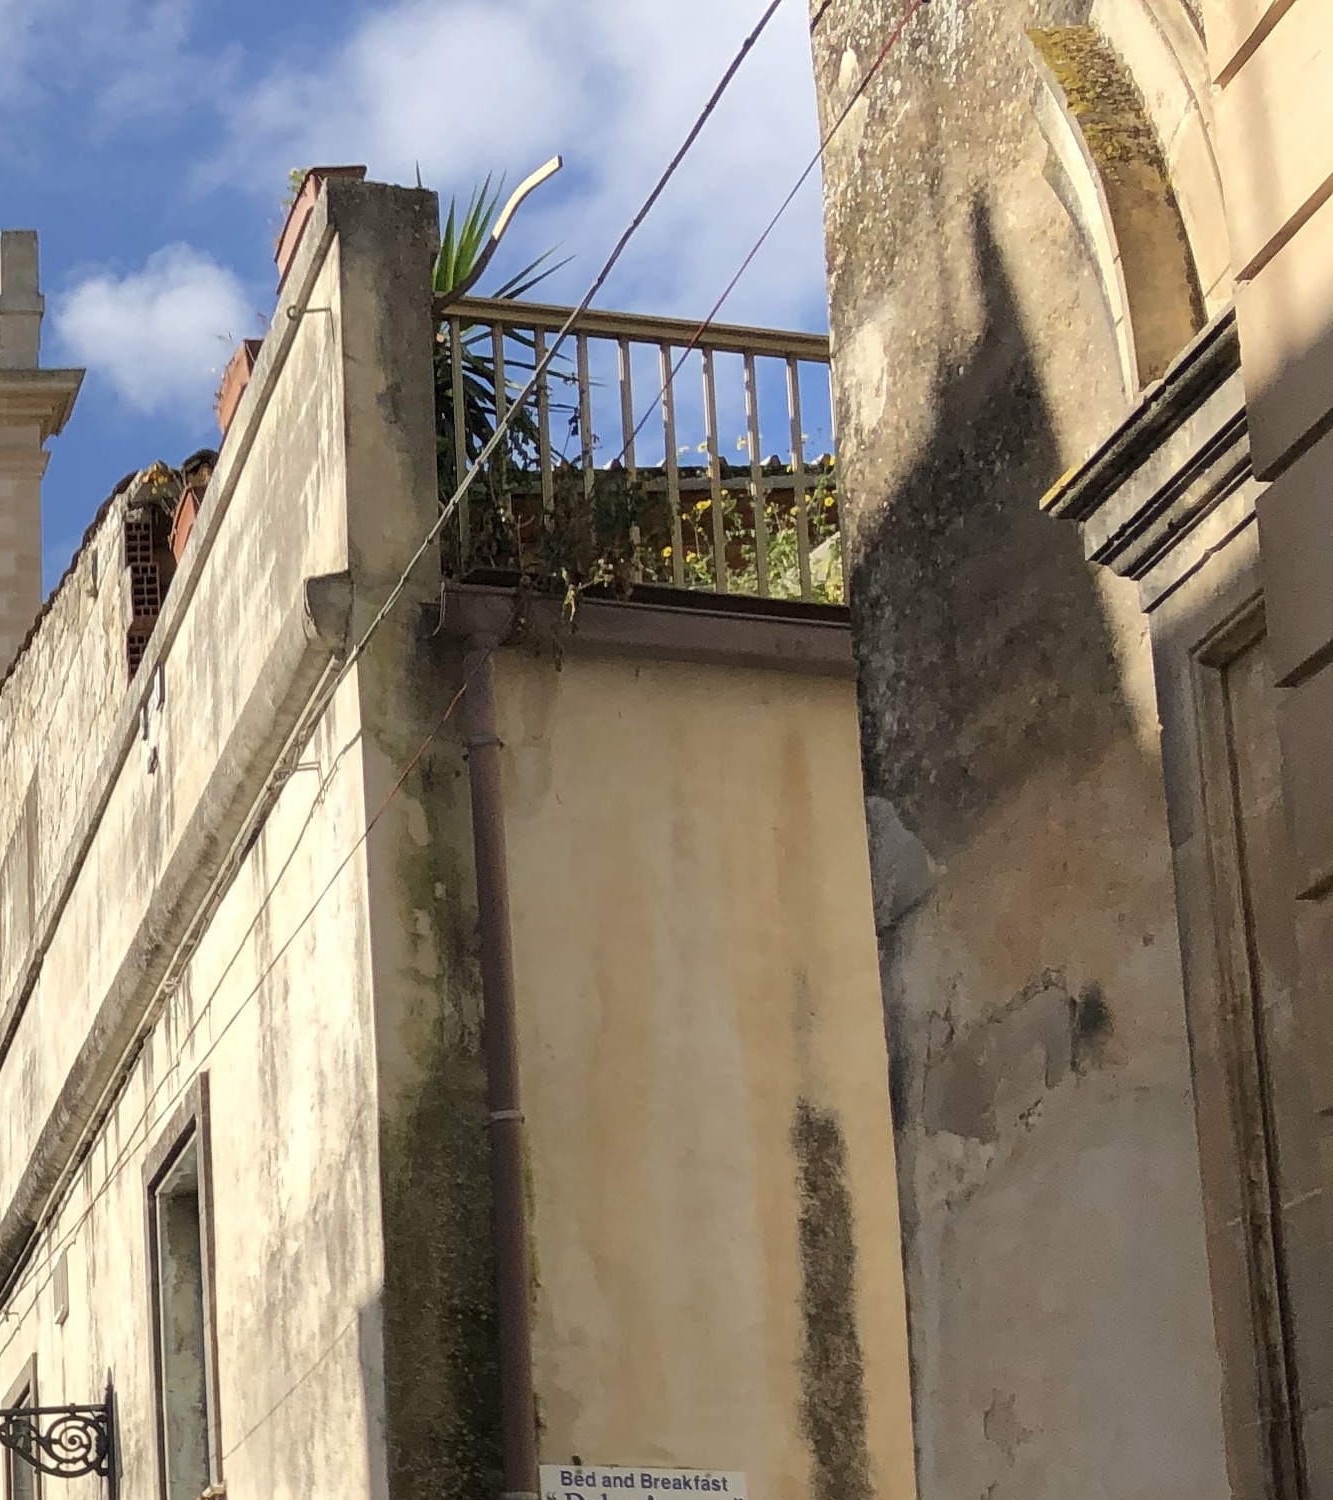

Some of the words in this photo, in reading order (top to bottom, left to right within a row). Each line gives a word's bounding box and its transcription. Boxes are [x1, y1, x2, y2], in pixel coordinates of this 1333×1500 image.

[560, 1470, 596, 1488] Bed
[602, 1473, 634, 1489] and
[641, 1473, 729, 1492] Breakfast
